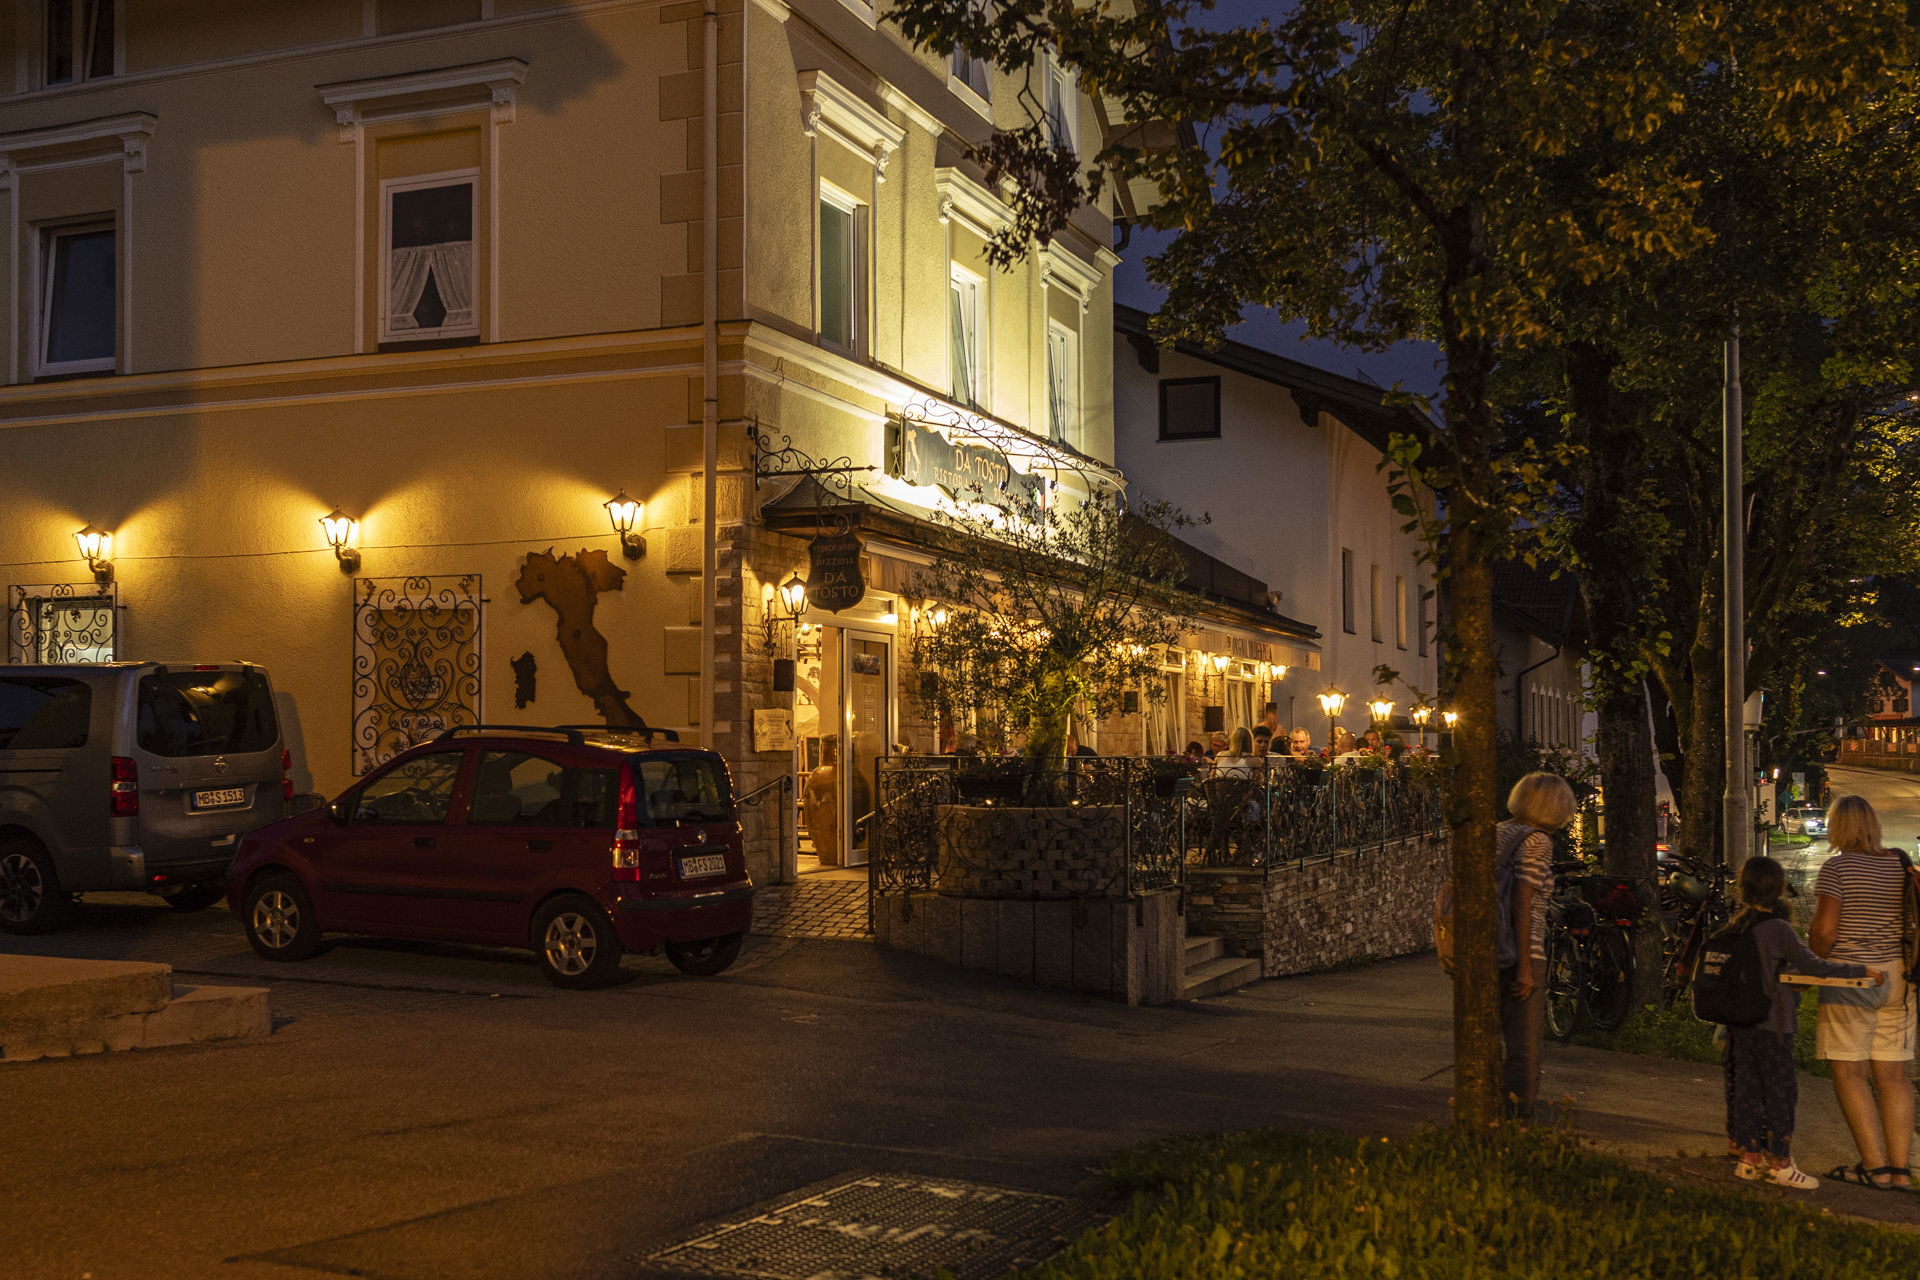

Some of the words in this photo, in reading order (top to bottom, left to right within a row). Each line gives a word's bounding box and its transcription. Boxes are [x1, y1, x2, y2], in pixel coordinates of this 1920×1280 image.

[955, 448, 972, 474] DA
[975, 456, 1009, 486] TOSTO
[824, 571, 848, 584] DA
[813, 585, 859, 599] TOSTO
[223, 789, 243, 802] 1513
